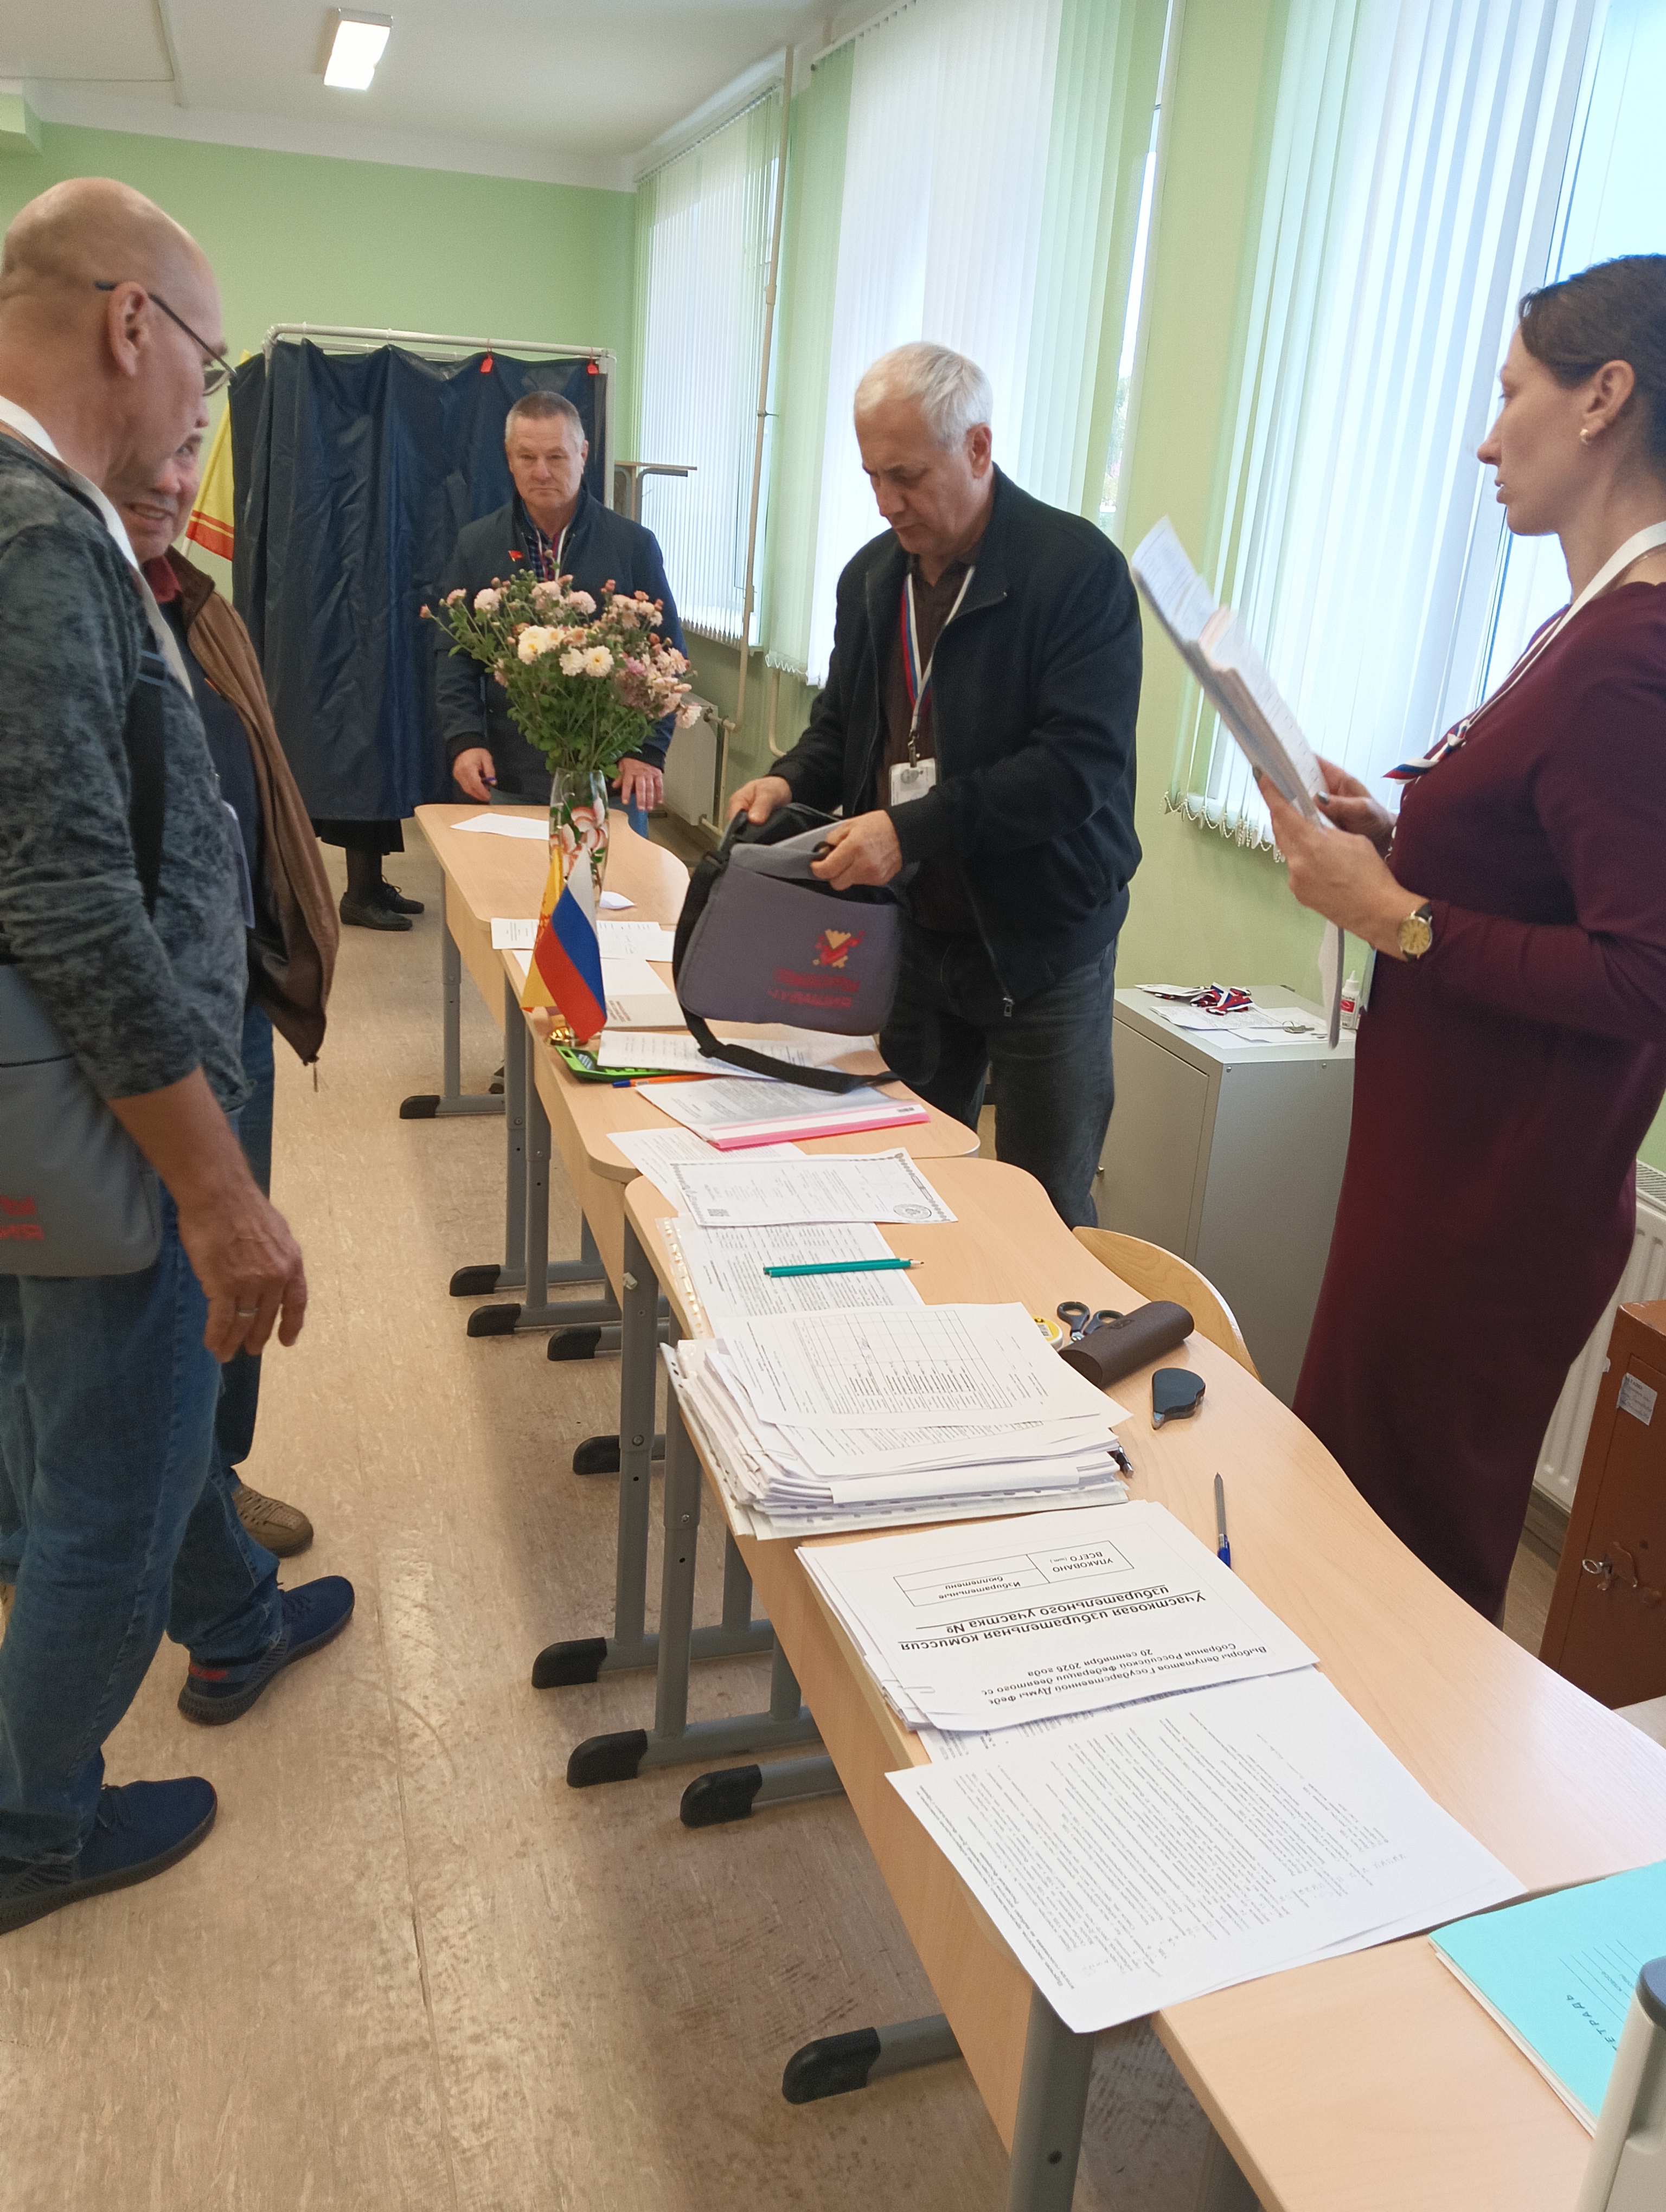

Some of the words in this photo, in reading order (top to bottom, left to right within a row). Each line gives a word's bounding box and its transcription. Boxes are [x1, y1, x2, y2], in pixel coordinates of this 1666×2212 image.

[1052, 1558, 1113, 1572] УПАКОВАНО
[1069, 1551, 1103, 1562] ВСЕГО
[938, 1581, 1021, 1599] Избирательные
[945, 1576, 1003, 1590] бюллетени
[1039, 1586, 1169, 1617] избирательного
[1111, 1592, 1205, 1617] Участковая
[968, 1608, 1035, 1628] участка
[984, 1611, 1108, 1640] избирательная
[900, 1635, 979, 1652] комиссия
[1184, 1643, 1236, 1658] Собрания
[1084, 1650, 1137, 1668] сентября
[1119, 1652, 1182, 1669] Российской
[1140, 1648, 1152, 1657] 20
[1221, 1645, 1267, 1661] Выборы
[1056, 1662, 1081, 1673] 2026
[1157, 1654, 1220, 1672] депутатов
[1027, 1667, 1053, 1677] года
[1054, 1667, 1155, 1693] Государственной
[1056, 1664, 1117, 1682] Федерации
[997, 1677, 1053, 1693] девятого
[1019, 1684, 1052, 1700] Думы
